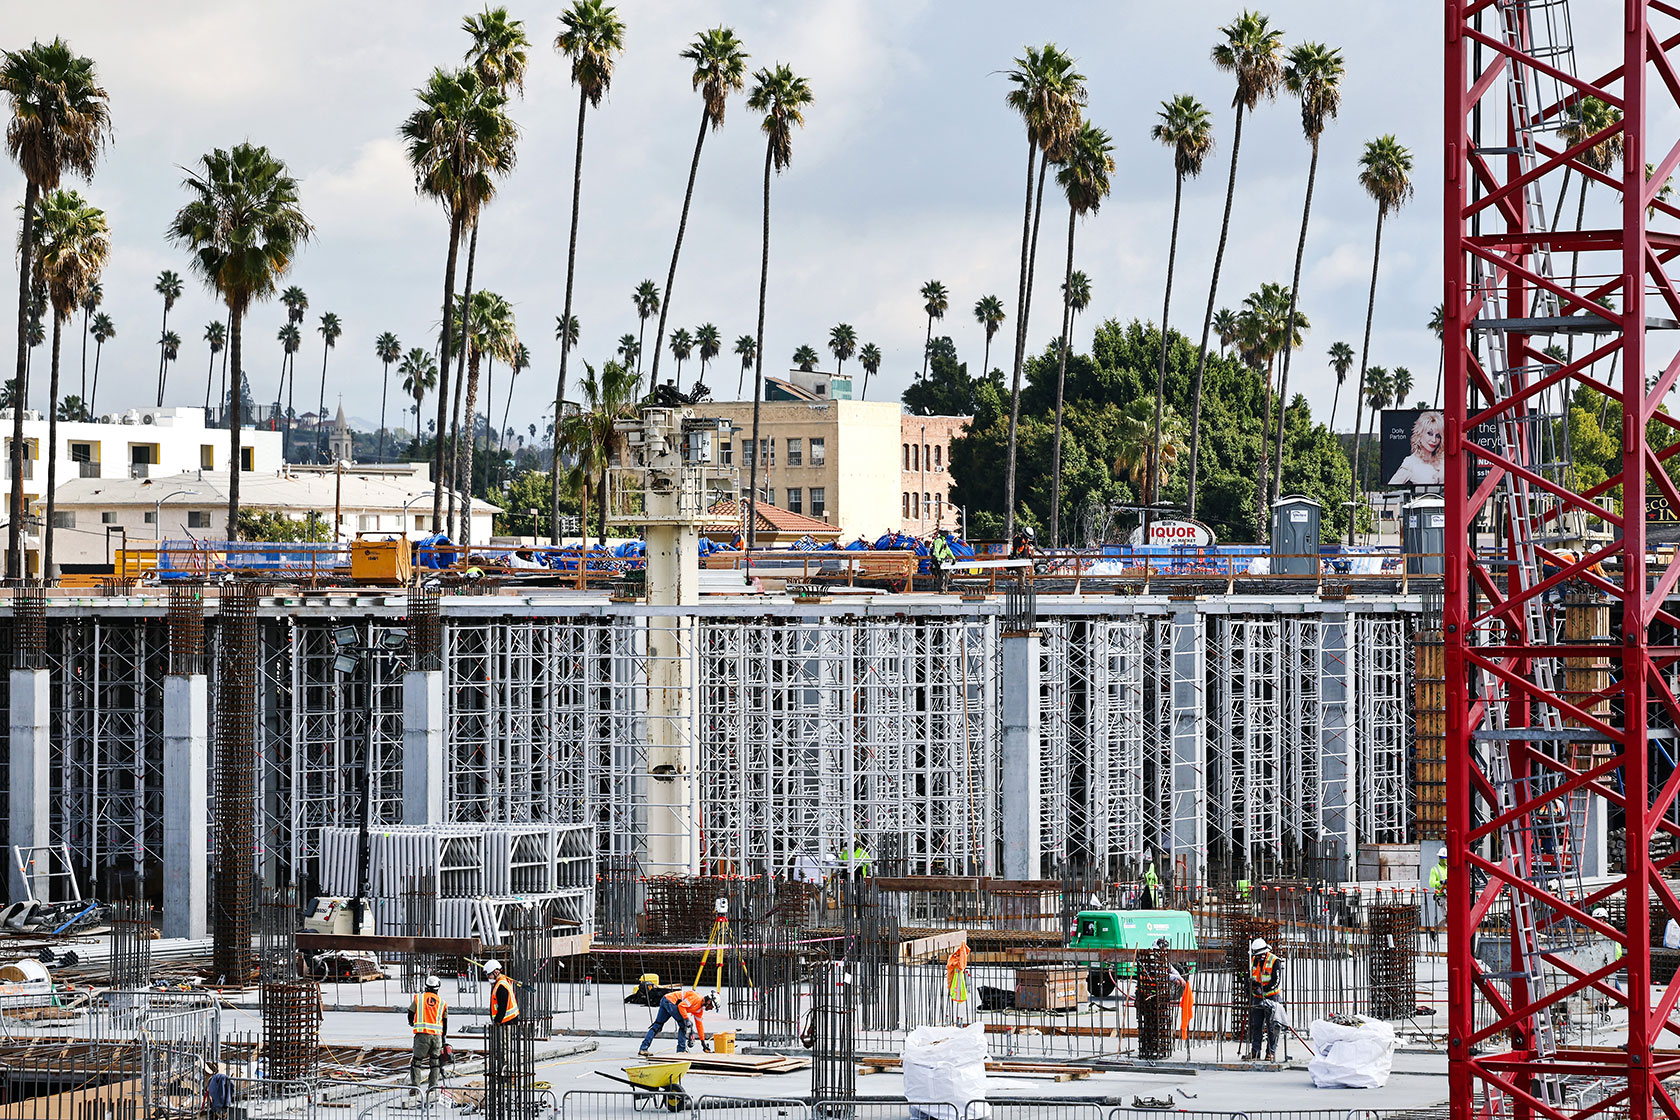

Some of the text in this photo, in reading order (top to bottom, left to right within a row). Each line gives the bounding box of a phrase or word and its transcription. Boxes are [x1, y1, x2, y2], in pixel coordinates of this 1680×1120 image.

[1391, 427, 1405, 435] Dolly
[1478, 422, 1497, 433] the
[1151, 527, 1196, 538] IQUOR
